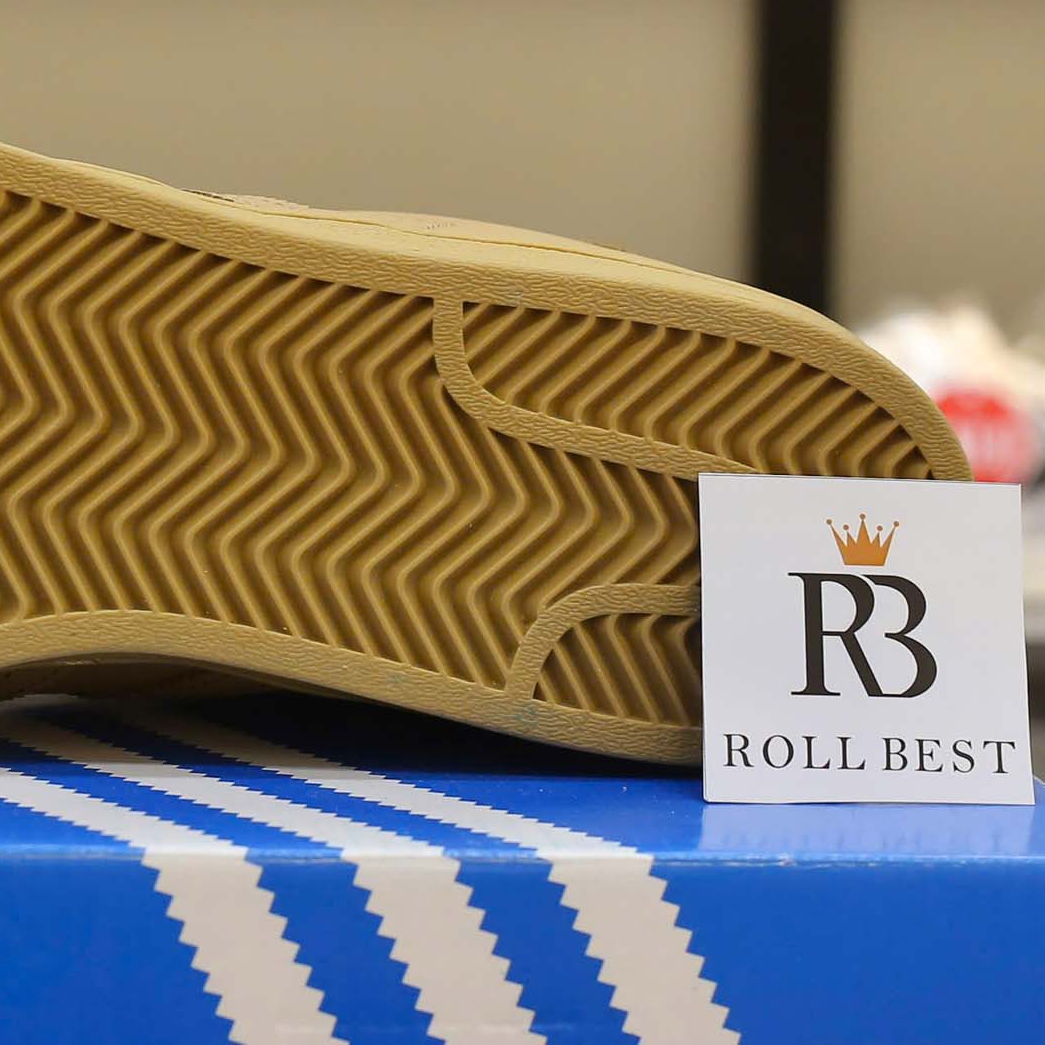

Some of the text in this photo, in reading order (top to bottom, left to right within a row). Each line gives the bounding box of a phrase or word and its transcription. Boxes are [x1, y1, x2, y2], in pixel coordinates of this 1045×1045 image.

[788, 572, 937, 698] RB
[723, 733, 1015, 774] ROLL BEST
